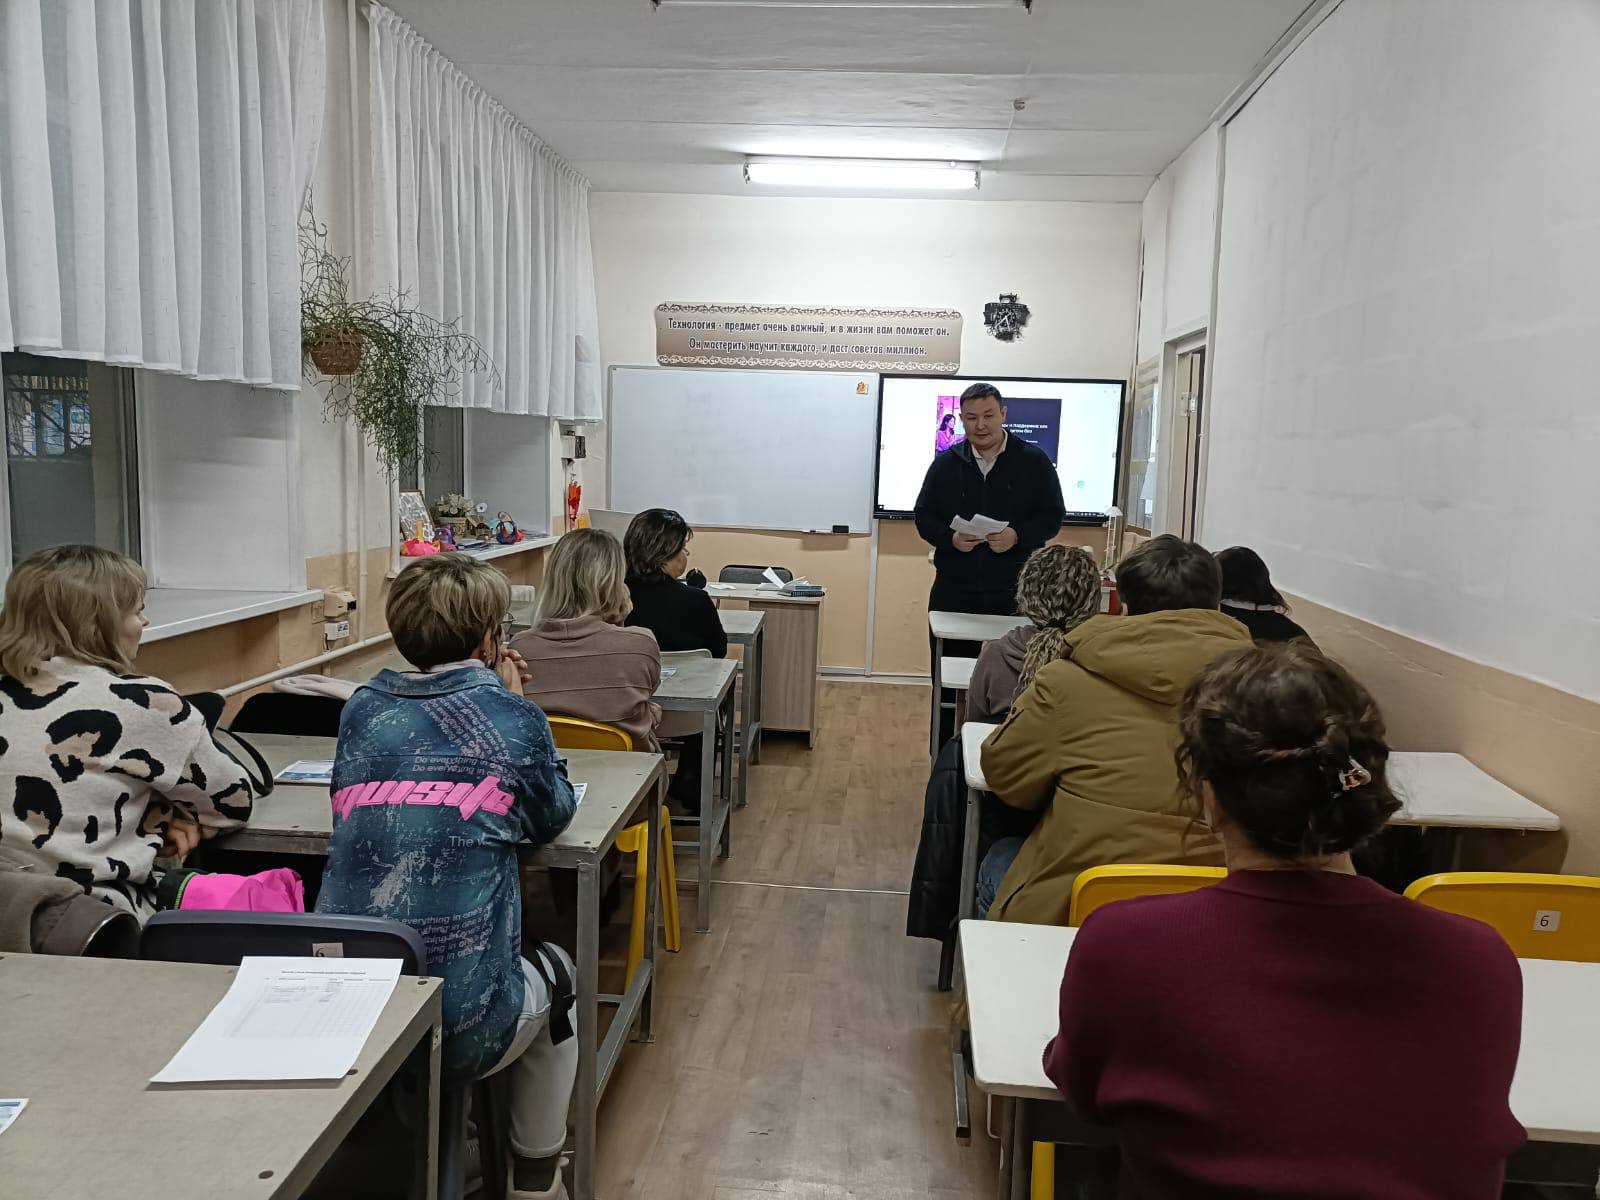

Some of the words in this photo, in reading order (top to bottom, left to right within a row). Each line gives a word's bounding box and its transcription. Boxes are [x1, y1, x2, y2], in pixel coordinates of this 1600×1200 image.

[668, 318, 716, 330] Технология
[724, 320, 760, 333] предмет
[763, 322, 788, 332] очень
[790, 322, 828, 335] важный,
[830, 324, 836, 333] и
[839, 325, 844, 333] в
[846, 325, 874, 334] жизни
[876, 326, 893, 335] вам
[896, 326, 934, 336] поможет
[689, 337, 701, 349] Он
[703, 340, 746, 352] мастерить
[749, 342, 778, 354] научит
[780, 342, 819, 354] каждого,
[822, 344, 827, 352] и
[829, 344, 848, 355] даст
[851, 344, 883, 354] советов
[886, 345, 928, 355] миллион.
[420, 701, 432, 713] Do
[415, 756, 428, 764] Do
[412, 764, 426, 772] Do
[476, 766, 485, 775] in
[449, 835, 474, 848] The
[402, 915, 451, 926] everything
[453, 913, 461, 921] in
[1540, 914, 1551, 927] 6
[314, 946, 326, 958] 6
